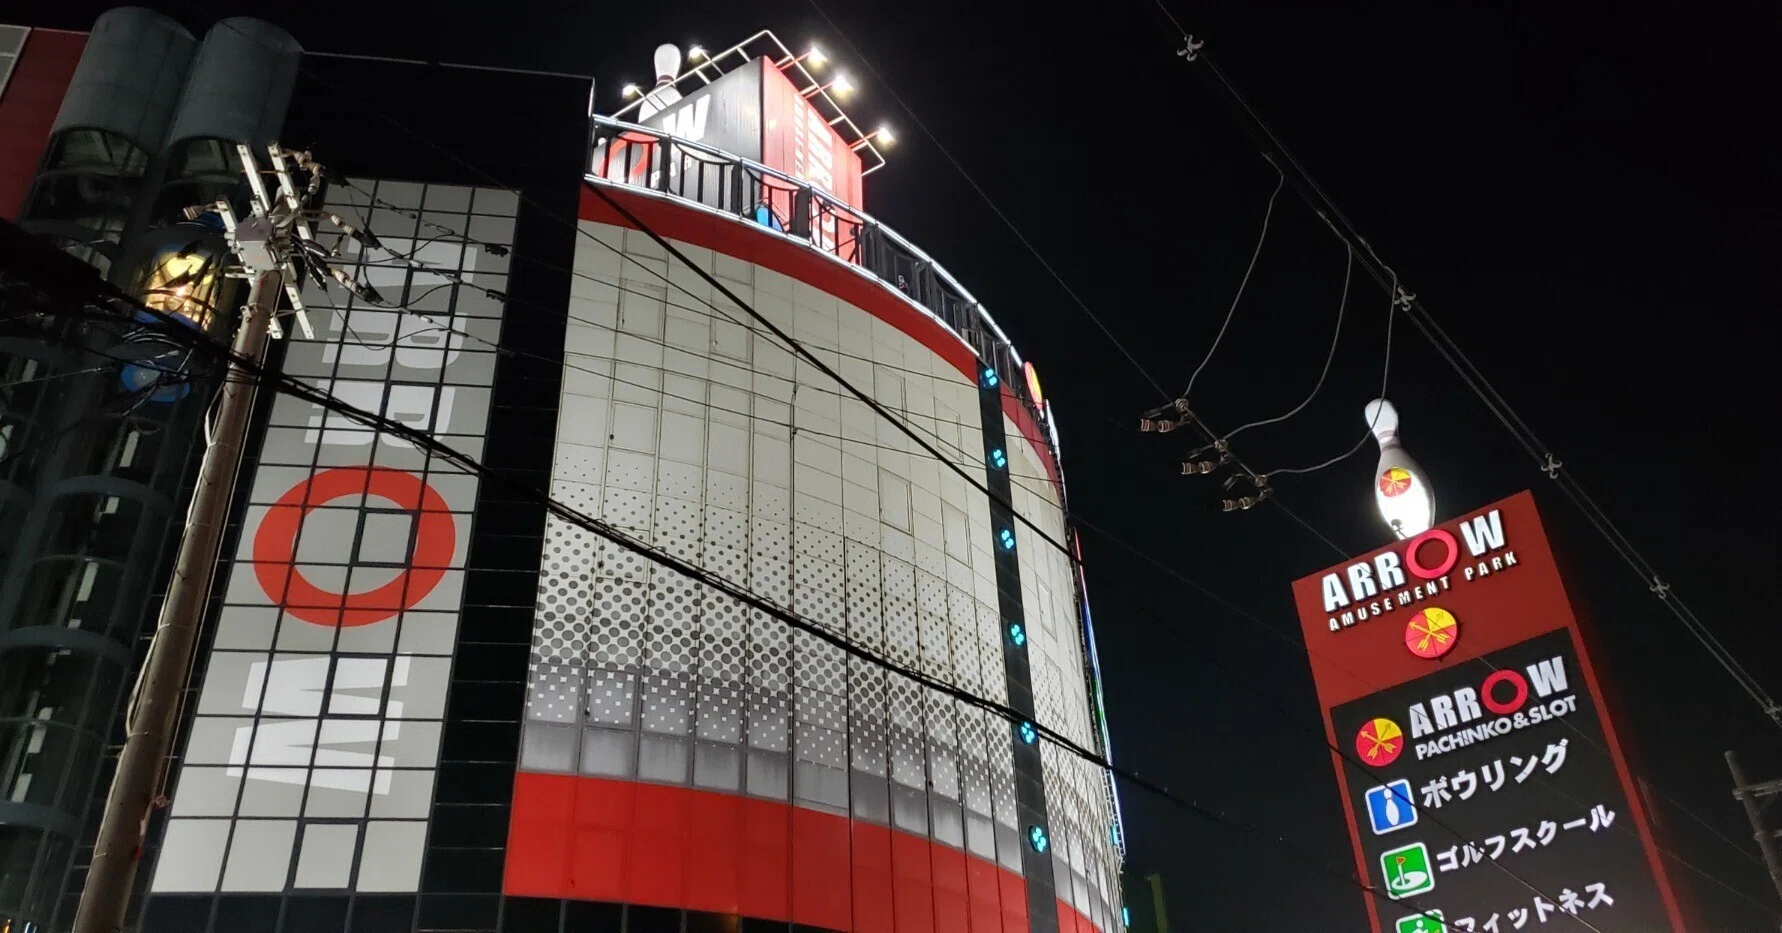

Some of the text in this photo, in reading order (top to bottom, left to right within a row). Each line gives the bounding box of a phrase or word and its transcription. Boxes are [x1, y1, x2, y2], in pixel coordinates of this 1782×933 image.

[227, 235, 478, 796] ARROW
[1322, 509, 1505, 612] ARROW
[1329, 551, 1517, 631] AMUSEMENT PARK
[1409, 655, 1568, 739] ARROW
[1415, 695, 1576, 760] PACHINKO&SLOT
[1421, 738, 1569, 809] ボウリング
[1436, 804, 1616, 872] ゴルフスクール
